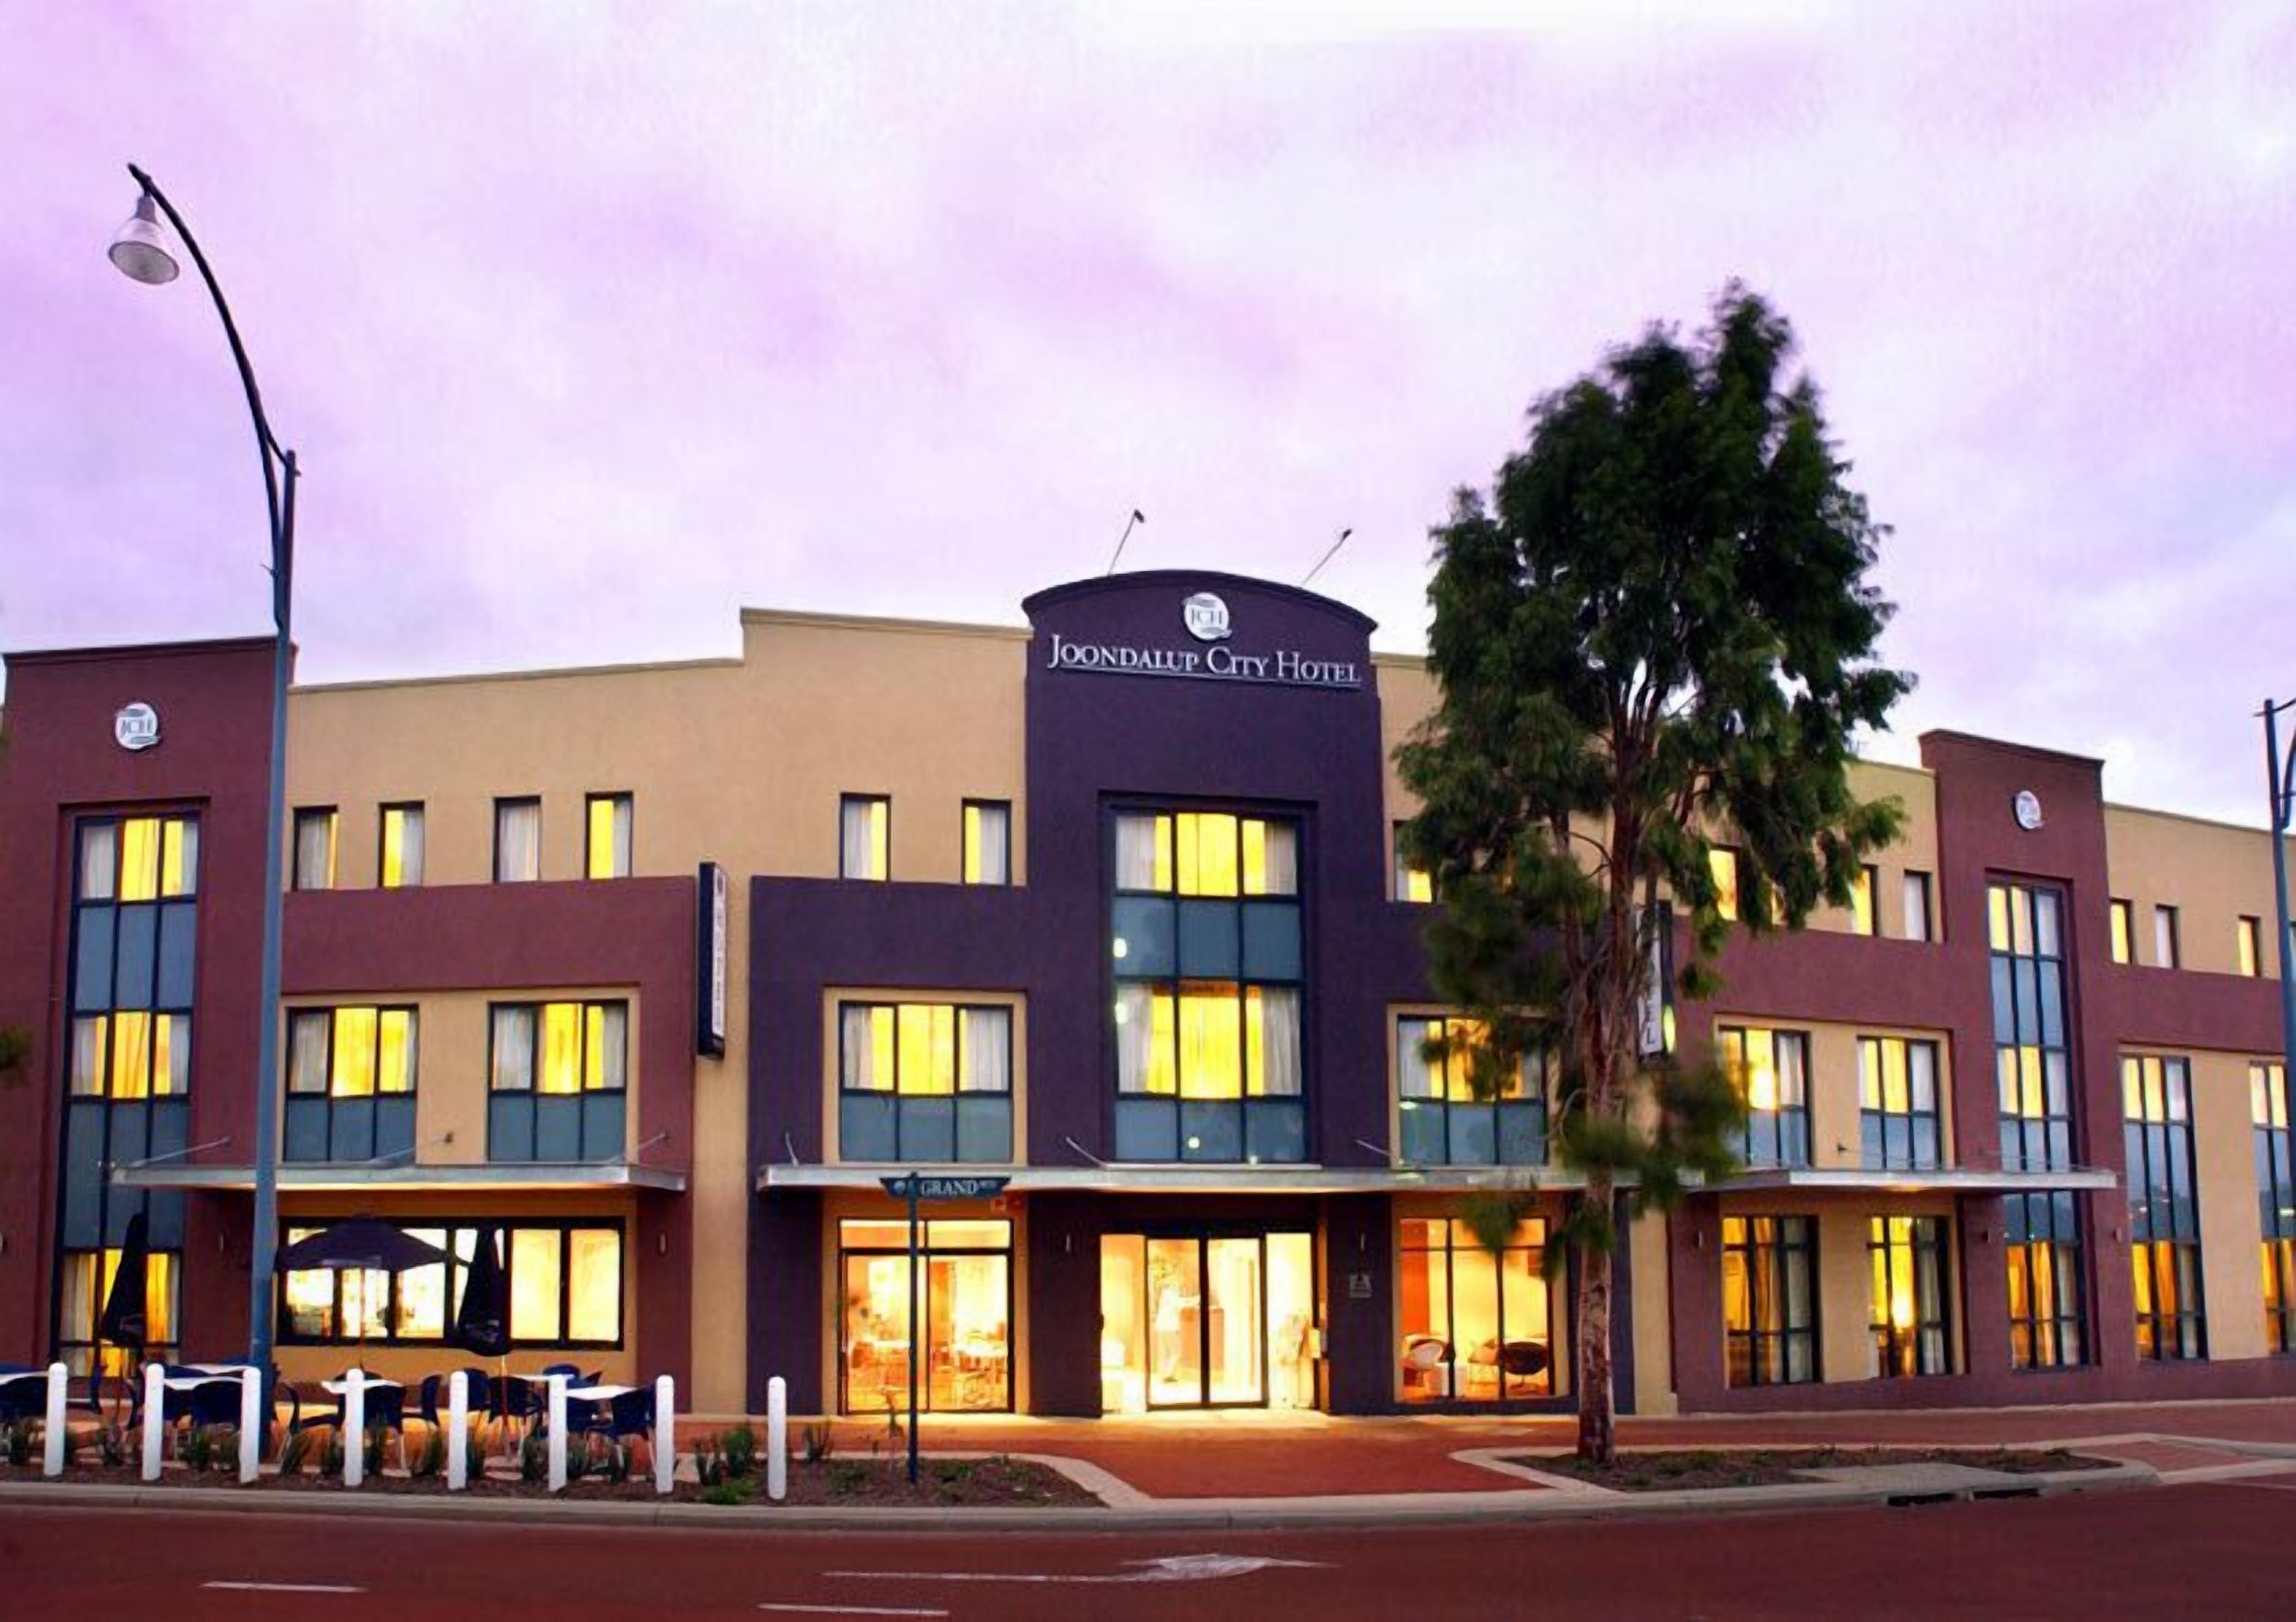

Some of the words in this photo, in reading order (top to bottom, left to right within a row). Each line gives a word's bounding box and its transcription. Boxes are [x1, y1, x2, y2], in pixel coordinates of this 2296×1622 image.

[1047, 634, 1200, 671] JOONDALUP
[1207, 646, 1269, 677] CITY
[1276, 650, 1361, 682] HOTEL
[922, 1180, 979, 1195] GRAND
